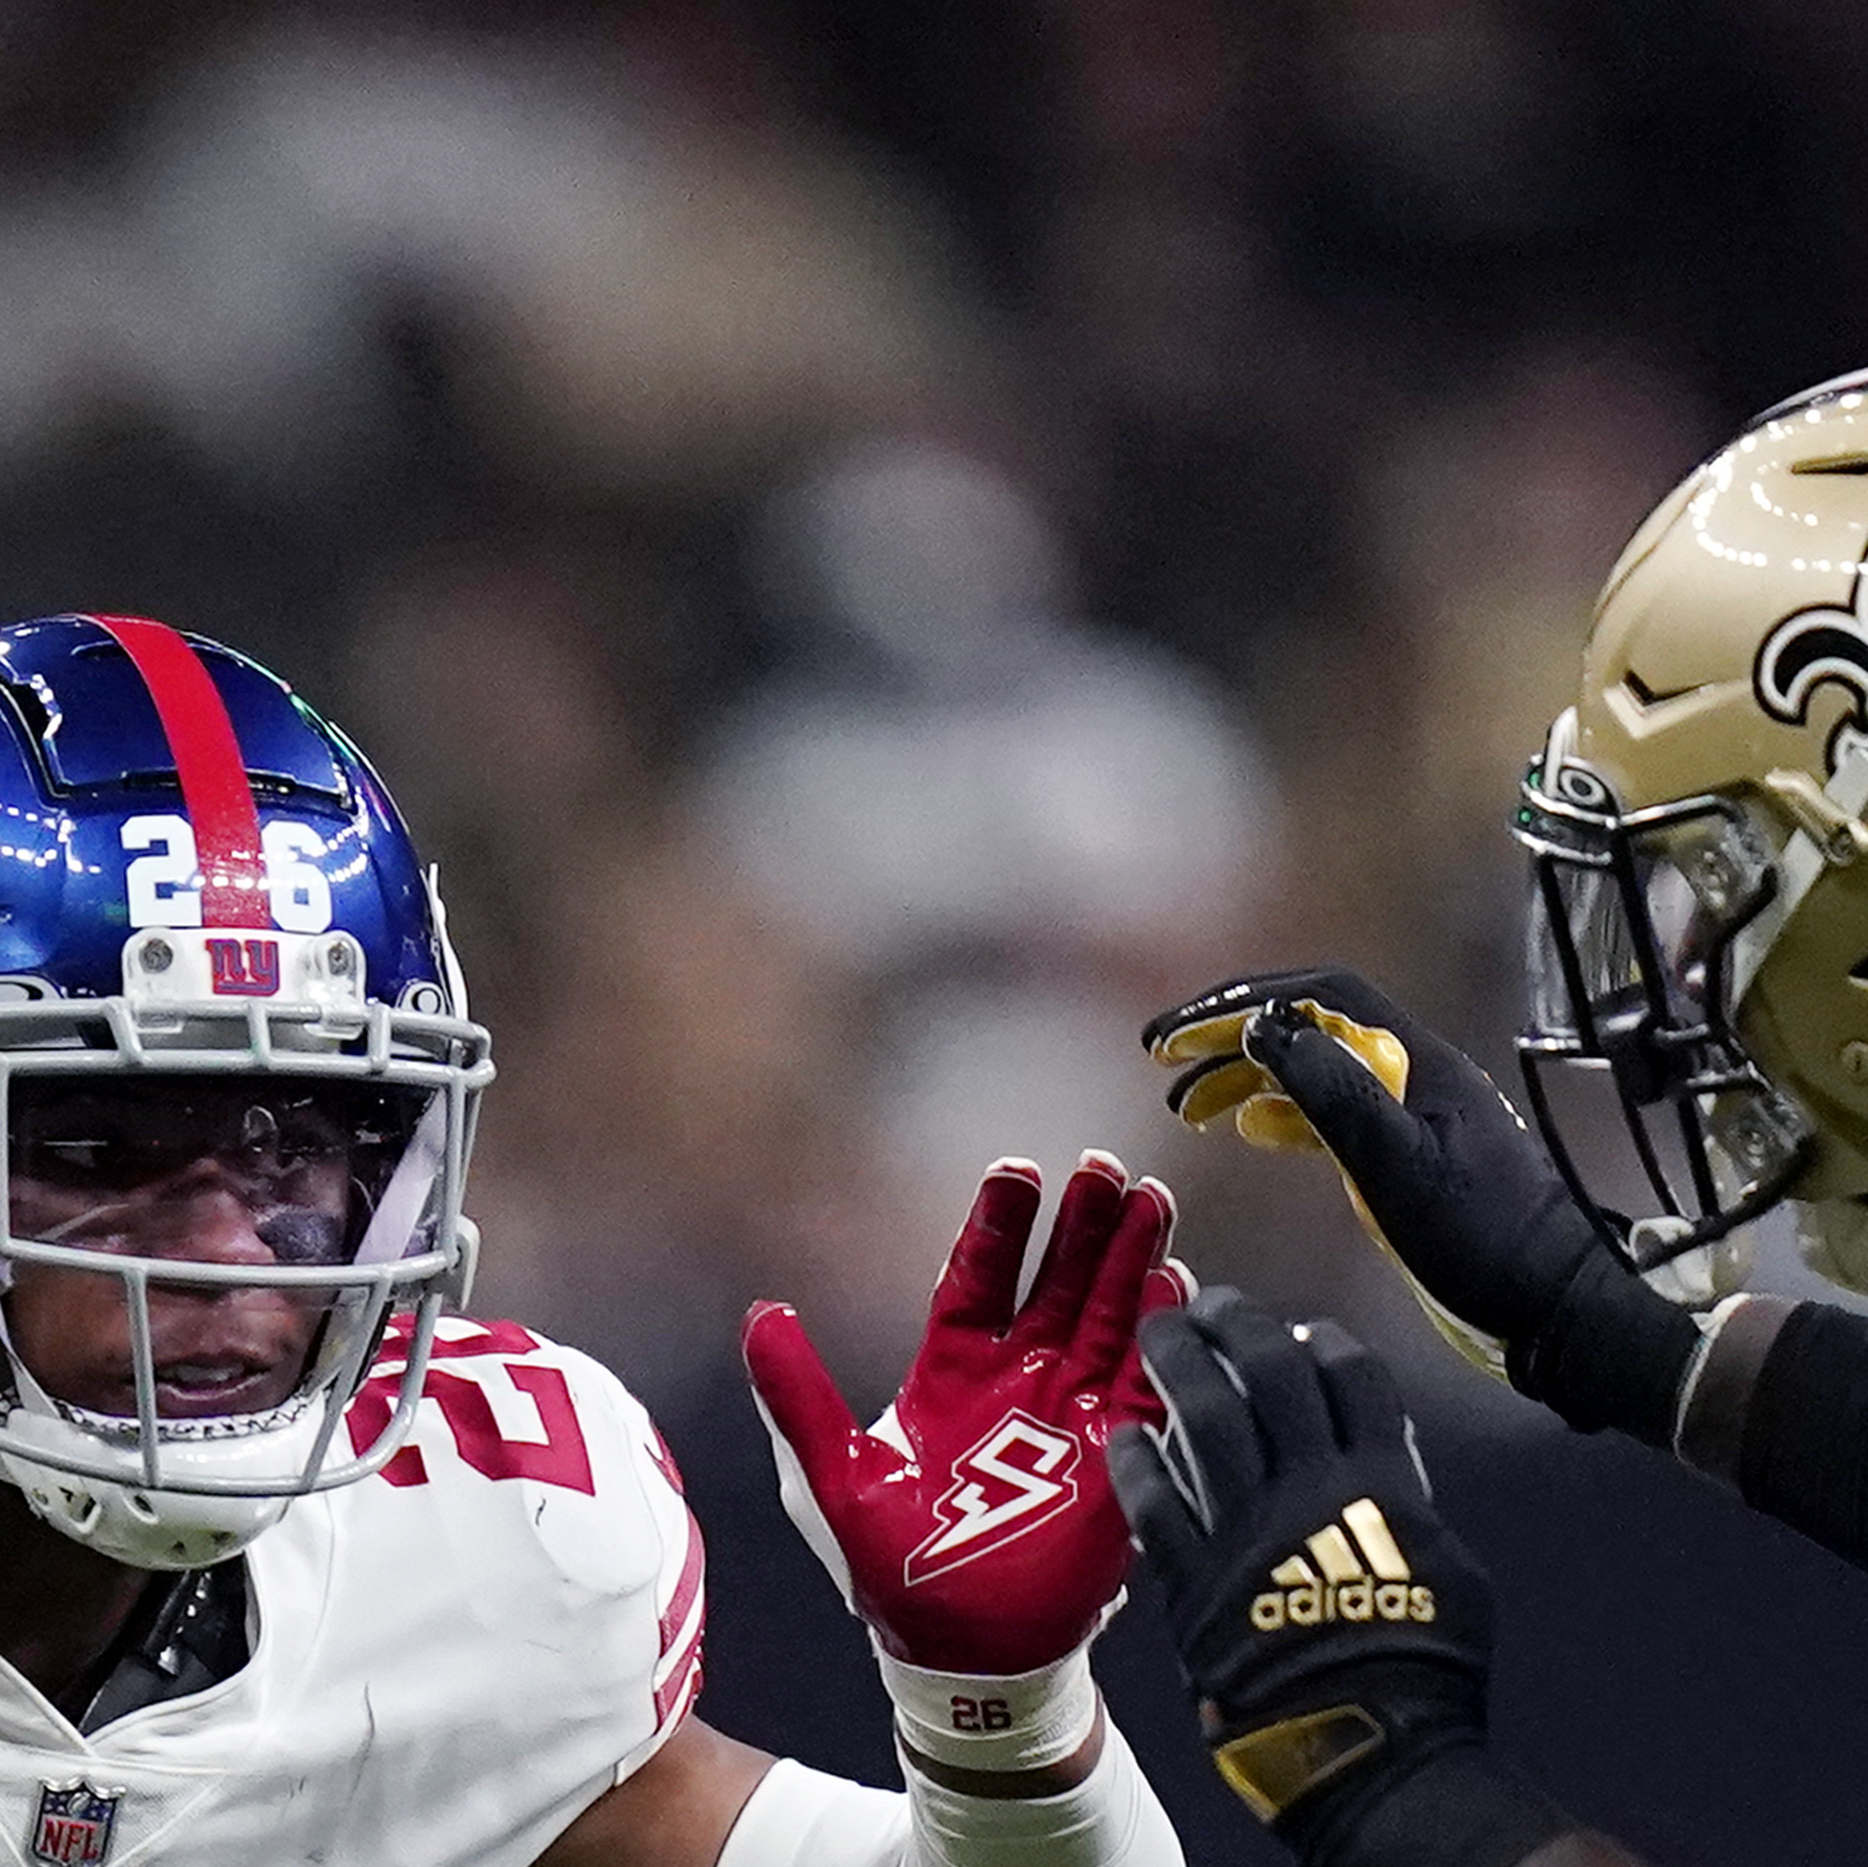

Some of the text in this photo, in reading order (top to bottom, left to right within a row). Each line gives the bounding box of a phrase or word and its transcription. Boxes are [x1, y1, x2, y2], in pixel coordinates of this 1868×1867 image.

[119, 814, 333, 935] 26
[1250, 1577, 1437, 1632] adidas
[949, 1695, 1012, 1732] 26
[38, 1816, 101, 1862] NFL
